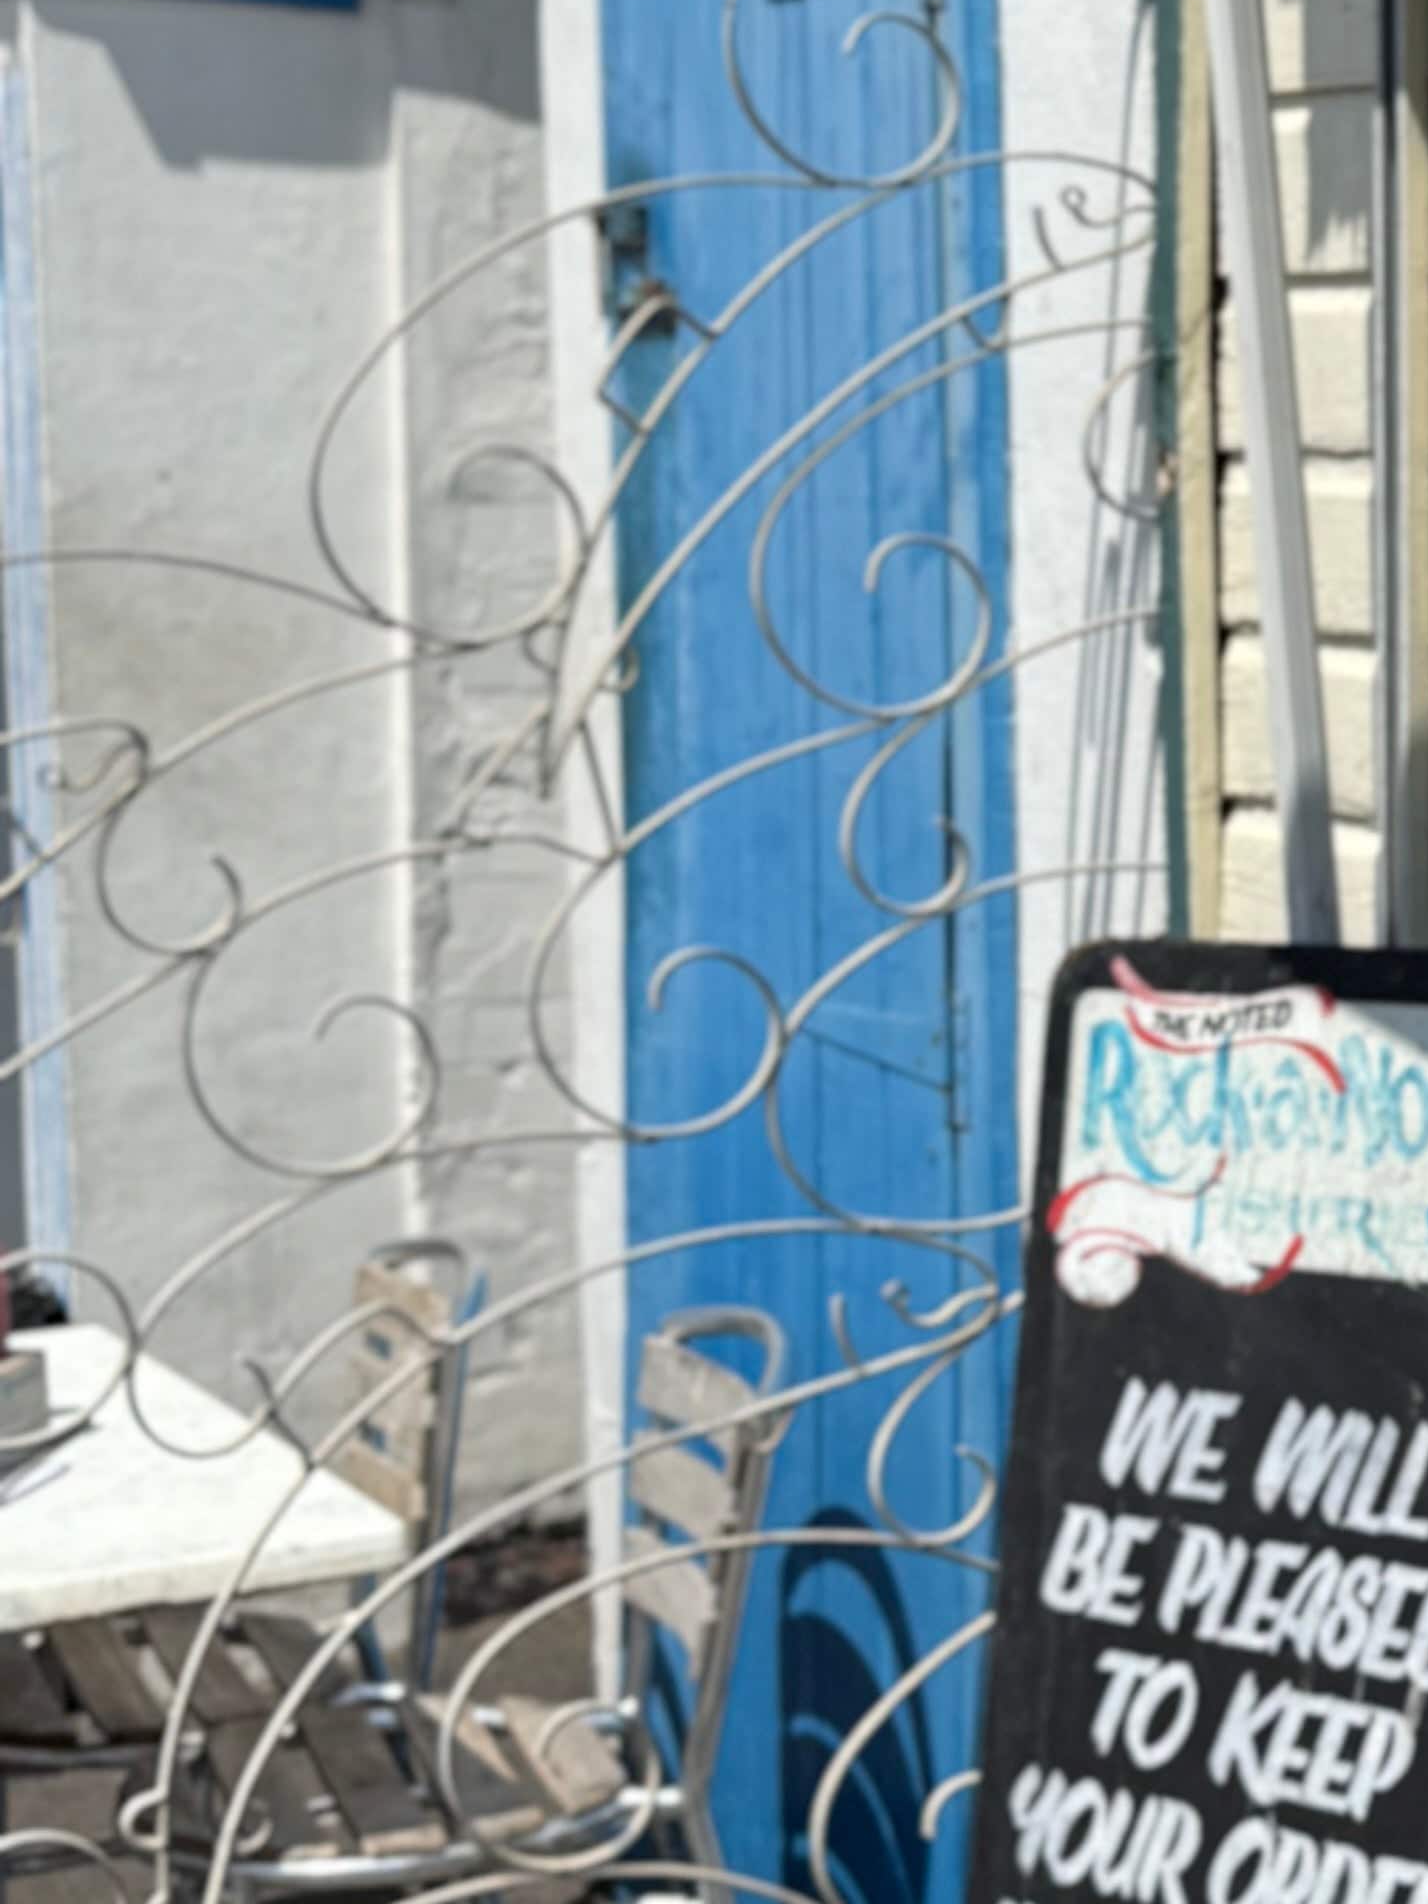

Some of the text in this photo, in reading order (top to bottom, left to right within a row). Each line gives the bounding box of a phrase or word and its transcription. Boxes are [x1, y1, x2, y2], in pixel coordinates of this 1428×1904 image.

[1099, 1374, 1243, 1505] WE
[1039, 1500, 1161, 1628] BE
[1089, 1646, 1417, 1824] TO KEEP
